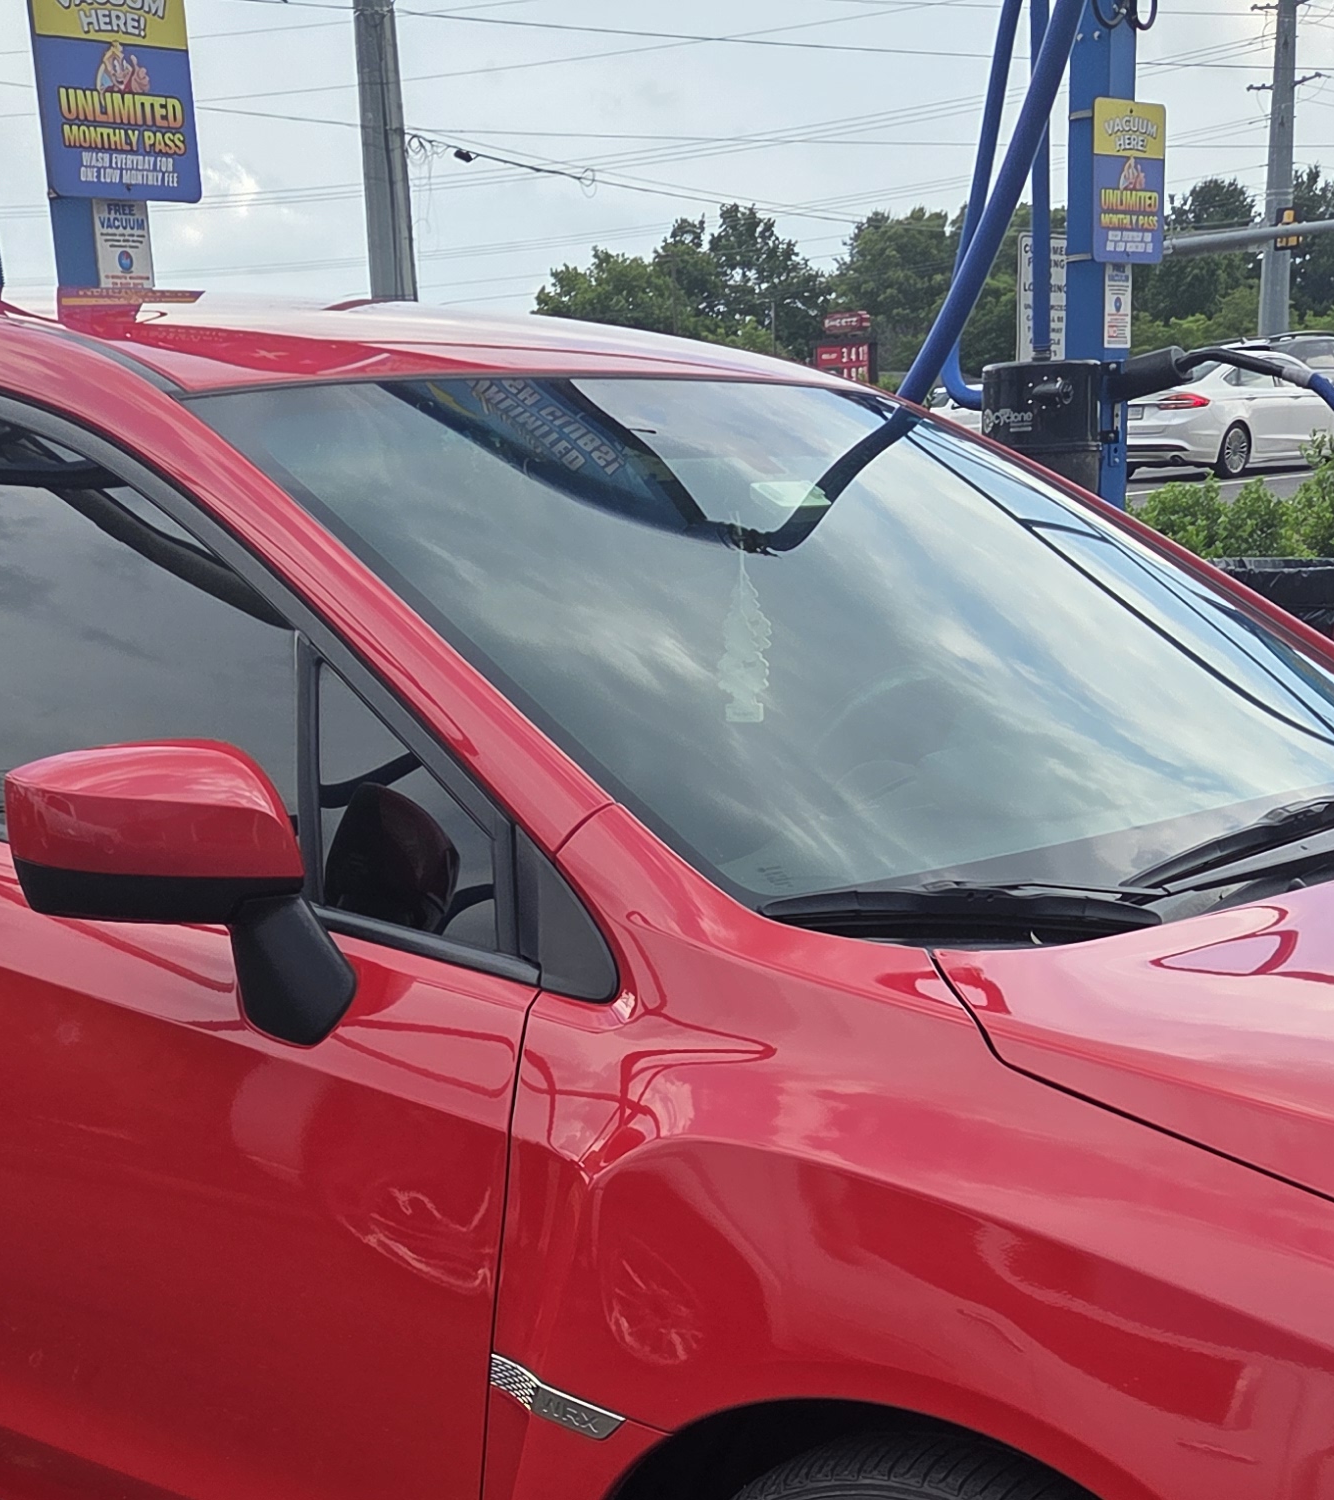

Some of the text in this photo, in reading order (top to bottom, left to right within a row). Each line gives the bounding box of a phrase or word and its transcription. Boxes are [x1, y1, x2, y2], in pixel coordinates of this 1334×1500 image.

[79, 9, 147, 38] HERE!
[58, 86, 184, 129] UNLIMITED
[1104, 116, 1158, 138] VACUUM
[63, 124, 186, 155] MONTHLY PASS
[82, 151, 173, 171] WASH EVERYDAY FOR
[80, 167, 178, 187] ONE LOW MONTHLY FEE
[107, 203, 136, 216] FREE
[1100, 188, 1159, 212] UNLIMITED
[98, 216, 146, 231] VACUUM
[1138, 215, 1159, 230] PASS
